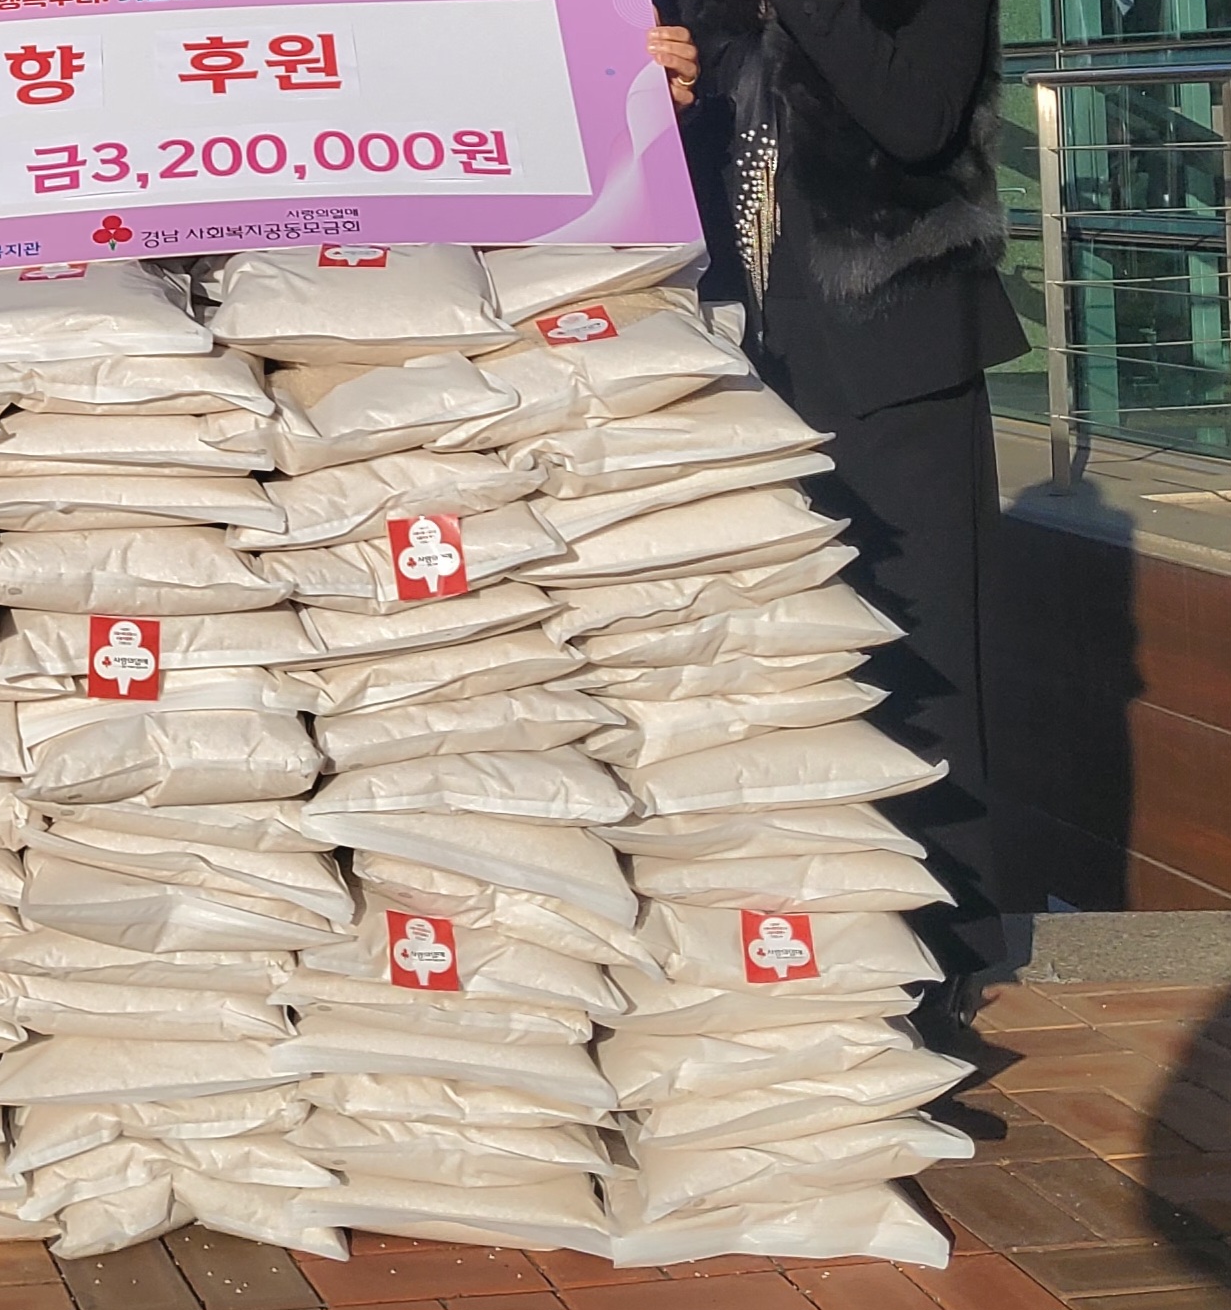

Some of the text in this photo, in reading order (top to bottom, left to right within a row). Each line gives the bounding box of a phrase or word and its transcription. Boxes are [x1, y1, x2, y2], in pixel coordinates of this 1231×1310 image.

[178, 33, 343, 94] 후원
[26, 129, 513, 194] 금3,200,000원
[141, 220, 361, 249] 경남 사회복지공동모금회
[286, 208, 360, 220] 사랑의열매
